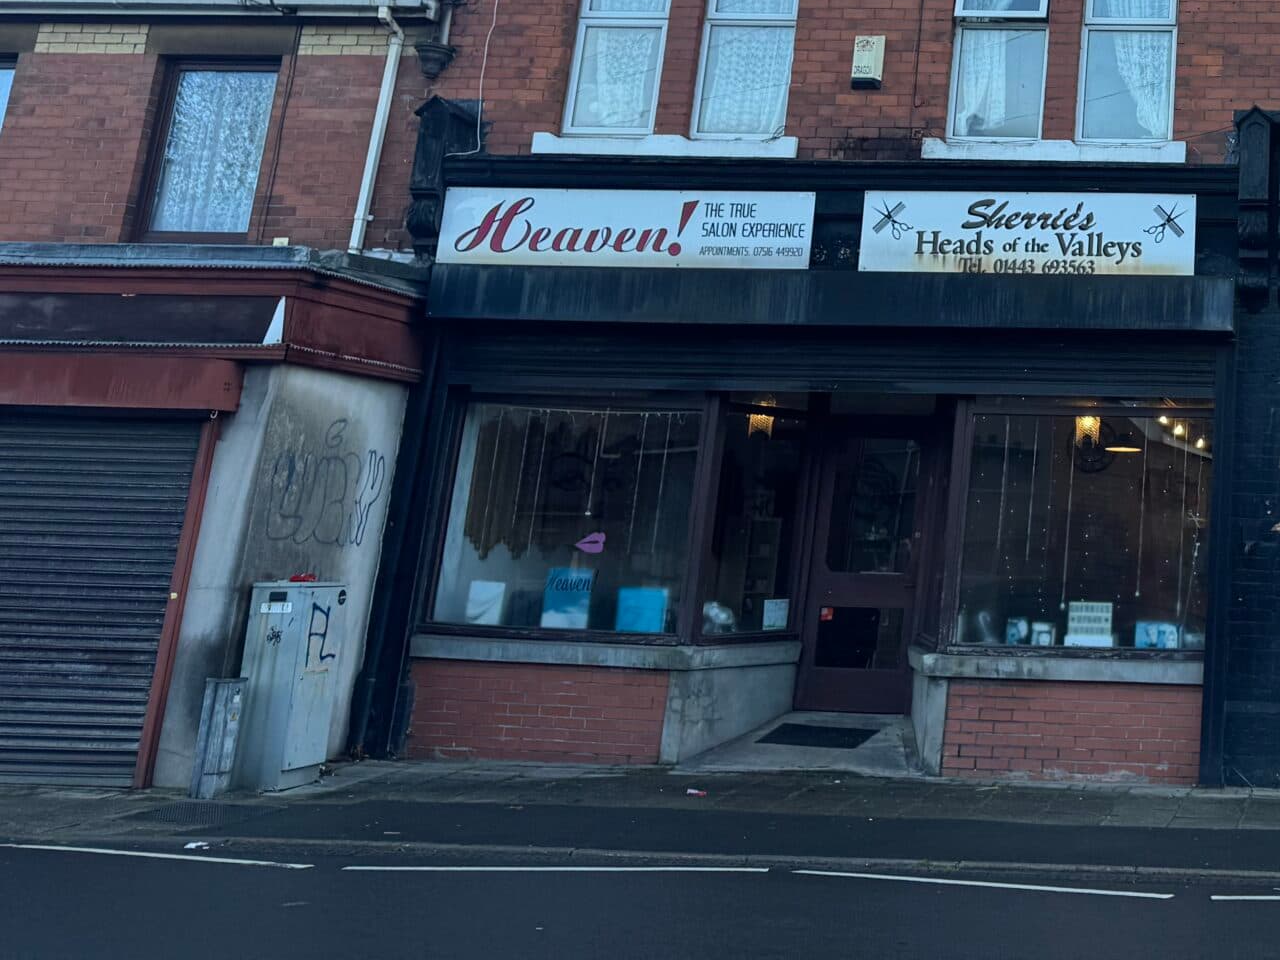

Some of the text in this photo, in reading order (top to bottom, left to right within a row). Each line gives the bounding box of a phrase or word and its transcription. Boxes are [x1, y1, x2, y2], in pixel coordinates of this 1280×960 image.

[704, 203, 757, 218] THE TRUE
[961, 199, 1097, 230] Sherrie's
[454, 197, 700, 257] Heaven!
[701, 222, 806, 239] SALON EXPERIENCE
[914, 230, 1143, 265] Heads of the Valleys
[993, 258, 1036, 274] 01443
